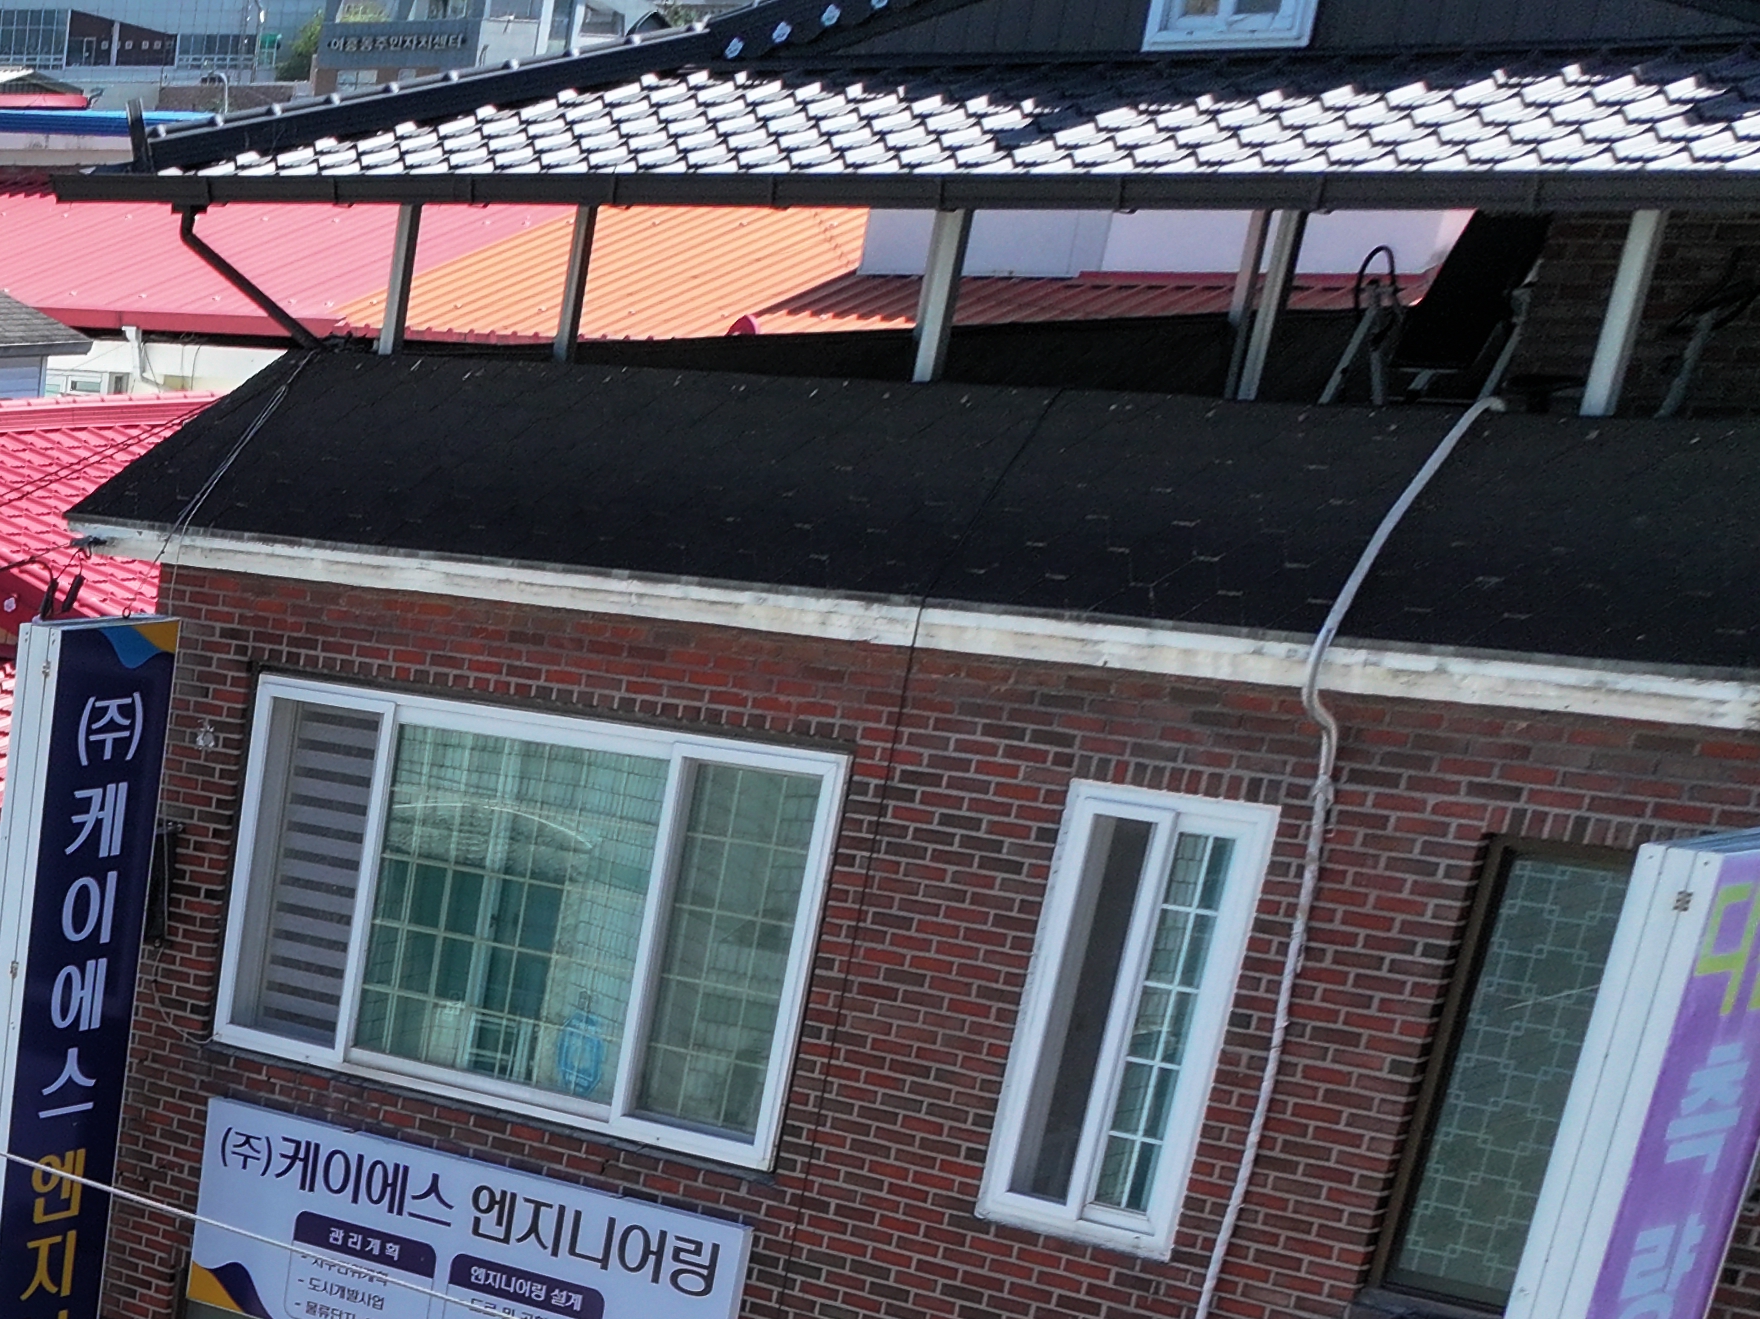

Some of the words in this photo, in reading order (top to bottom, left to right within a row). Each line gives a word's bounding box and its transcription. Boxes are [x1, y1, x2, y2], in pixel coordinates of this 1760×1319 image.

[328, 1226, 401, 1262] 관리계획
[471, 1183, 720, 1299] 엔지니어링
[308, 1277, 385, 1312] 도시개발사업
[470, 1266, 547, 1300] 엔지니어링
[550, 1287, 584, 1312] 설계
